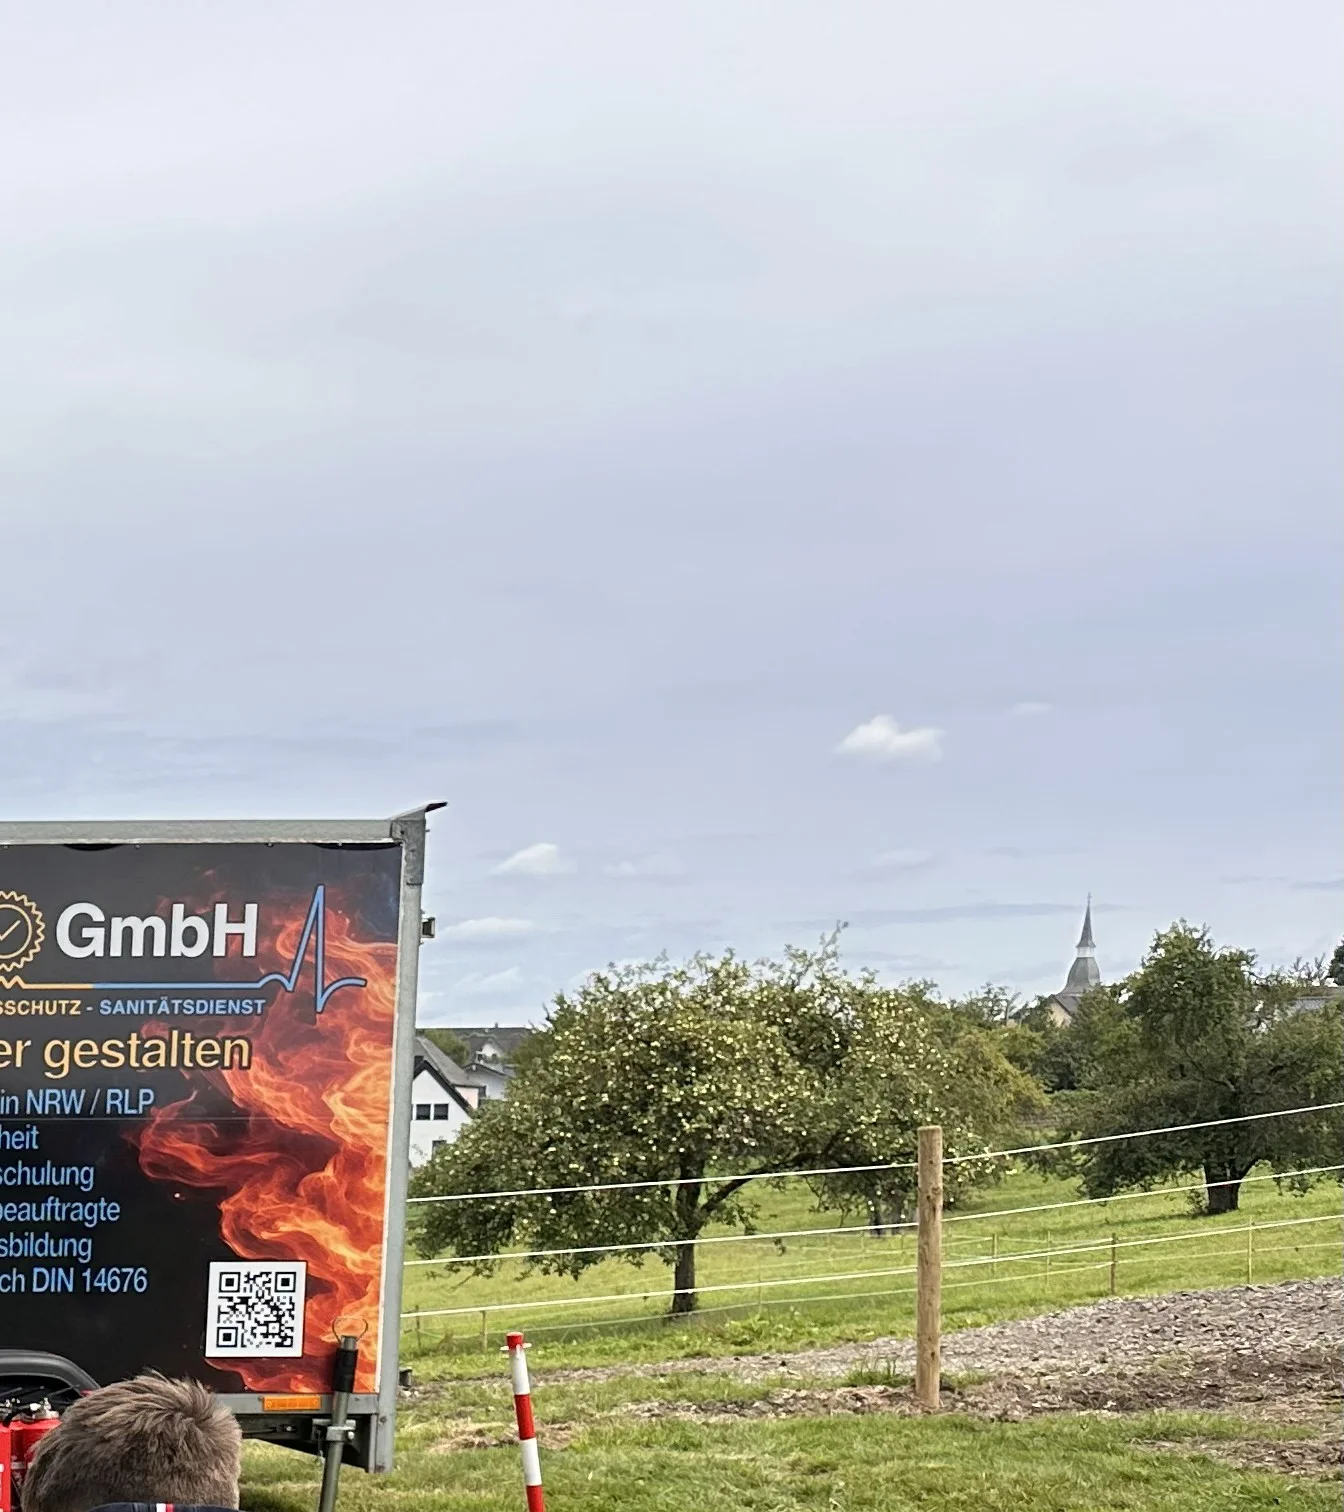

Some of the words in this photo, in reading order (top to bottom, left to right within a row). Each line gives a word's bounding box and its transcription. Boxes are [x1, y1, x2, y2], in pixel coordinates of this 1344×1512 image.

[56, 902, 257, 959] GmbH
[99, 997, 266, 1016] SANITÄTSDIENST
[44, 1030, 250, 1078] gestalten
[0, 1089, 19, 1115] in
[26, 1088, 85, 1114] NRW
[89, 1088, 100, 1114] /
[106, 1088, 154, 1114] RLP
[32, 1267, 74, 1293] DIN
[82, 1267, 147, 1293] 14676
